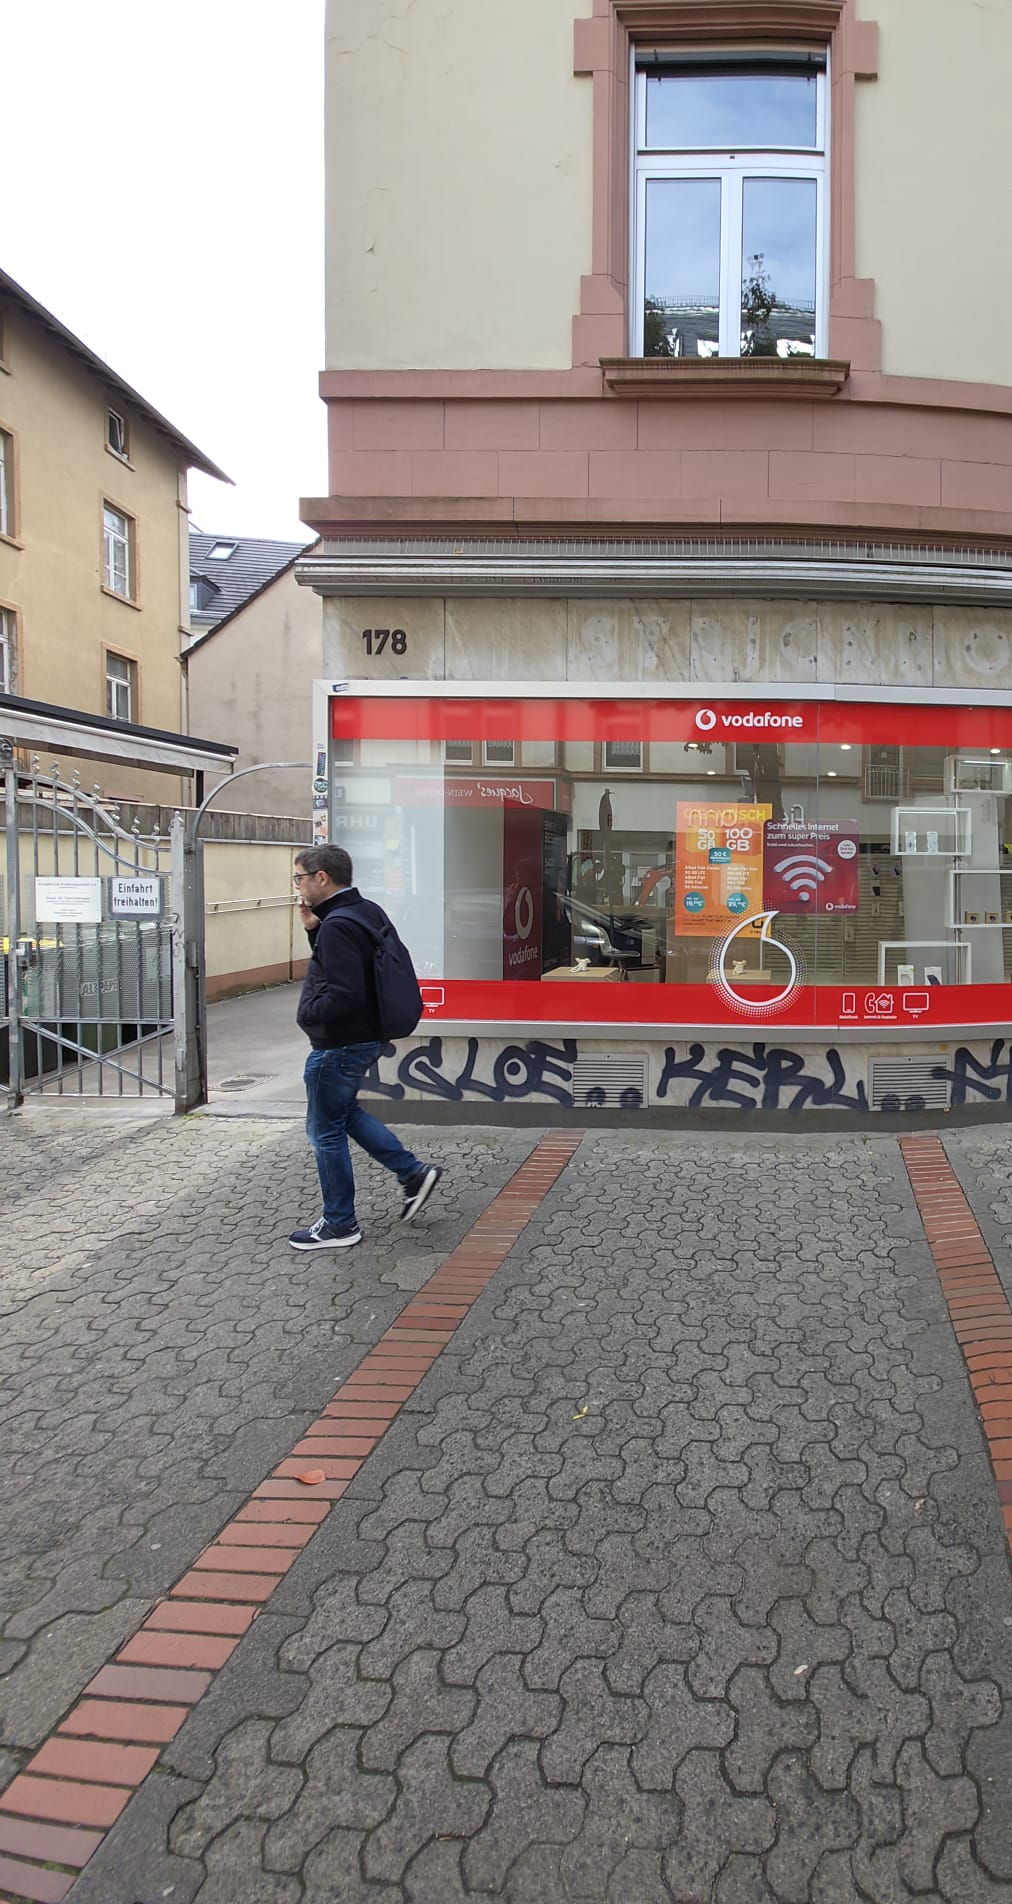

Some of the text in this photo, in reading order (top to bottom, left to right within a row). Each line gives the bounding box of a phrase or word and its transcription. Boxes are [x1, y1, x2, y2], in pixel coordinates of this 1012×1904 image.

[362, 629, 407, 655] 178
[721, 712, 803, 727] vodafone
[767, 822, 839, 831] Schnelles Internet
[697, 828, 753, 840] 50 100
[788, 833, 809, 841] super
[726, 840, 751, 851] GB
[118, 883, 153, 893] Einfahrt
[114, 897, 158, 906] freihalten!
[508, 945, 538, 967] vodafone
